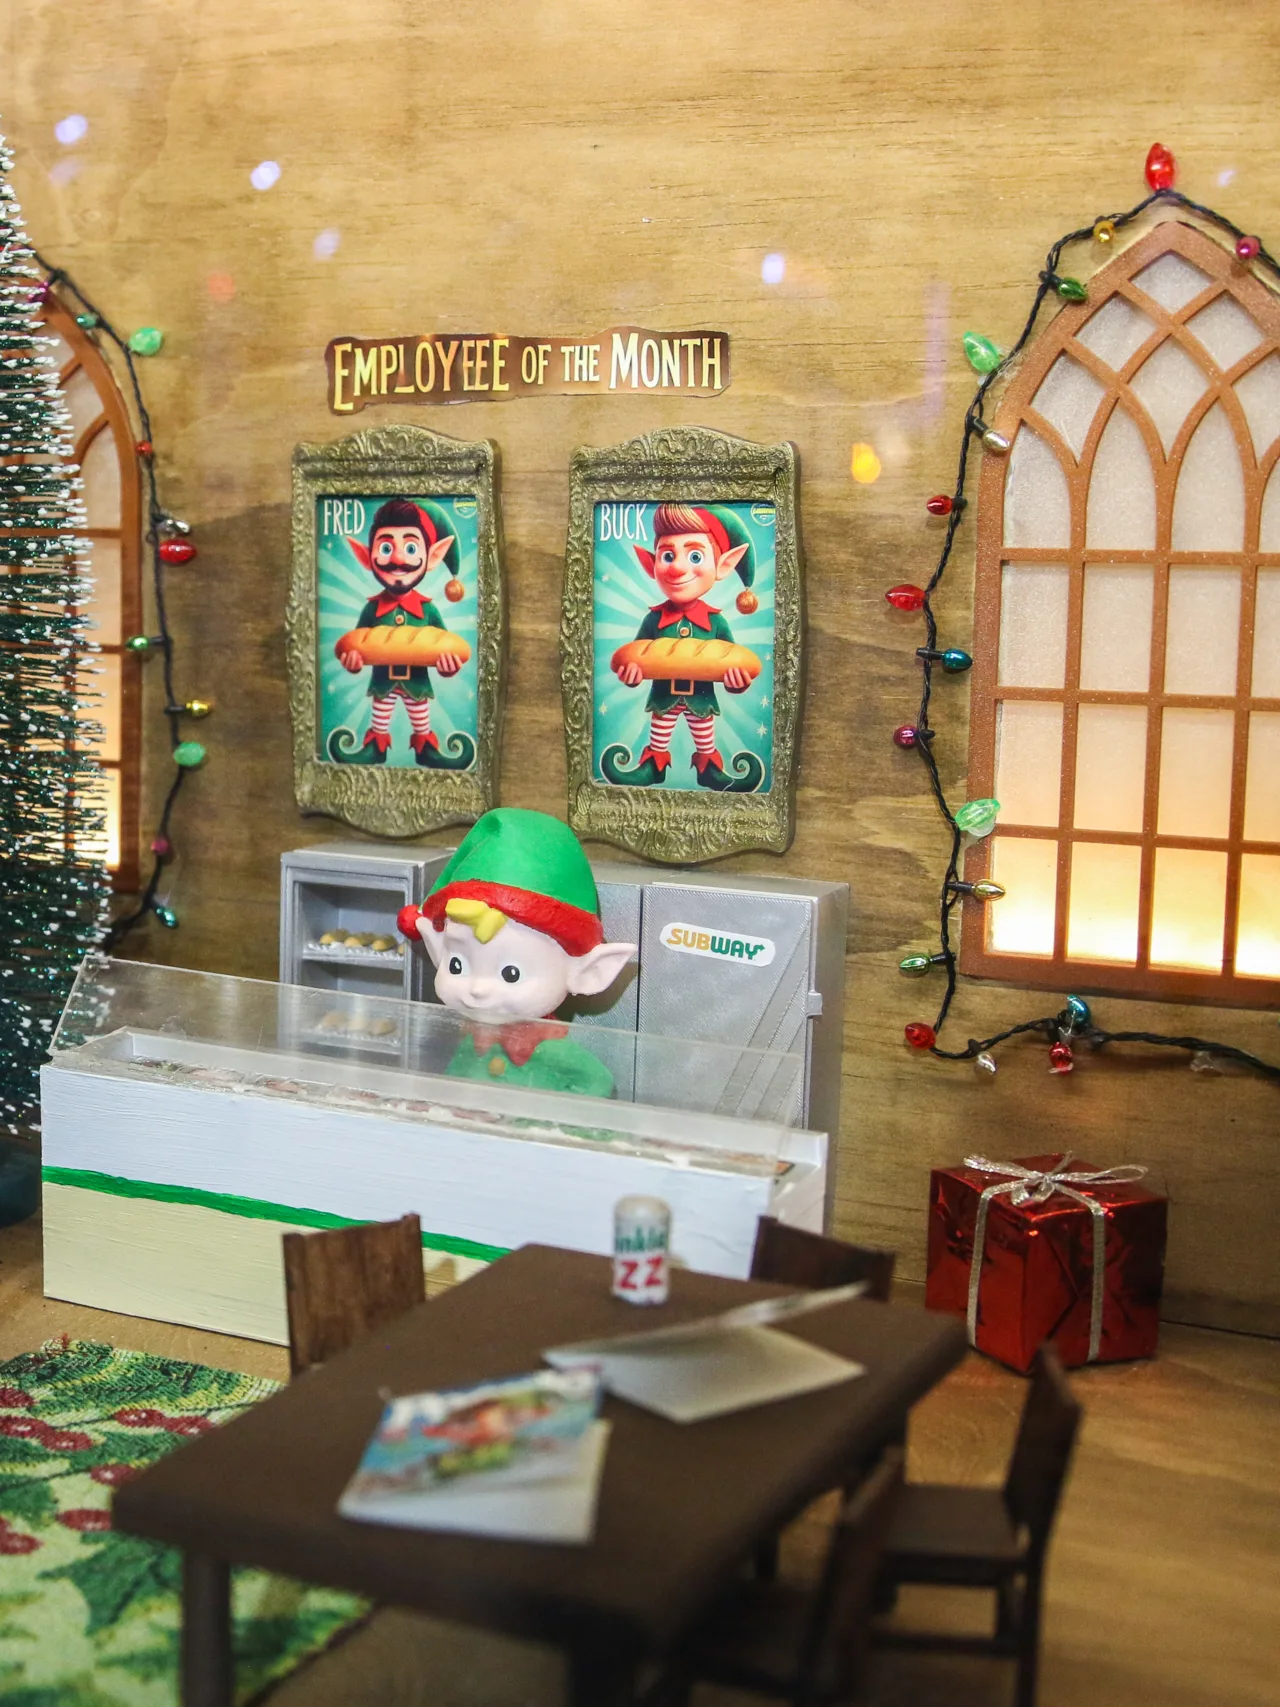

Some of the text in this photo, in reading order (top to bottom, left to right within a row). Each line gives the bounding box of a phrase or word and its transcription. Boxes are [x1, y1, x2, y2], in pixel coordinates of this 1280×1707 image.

[334, 332, 723, 411] EMPLOYEEE OF THE MONTH
[323, 499, 365, 535] FRED
[600, 503, 648, 541] BUCK
[666, 928, 765, 960] SUBWAY
